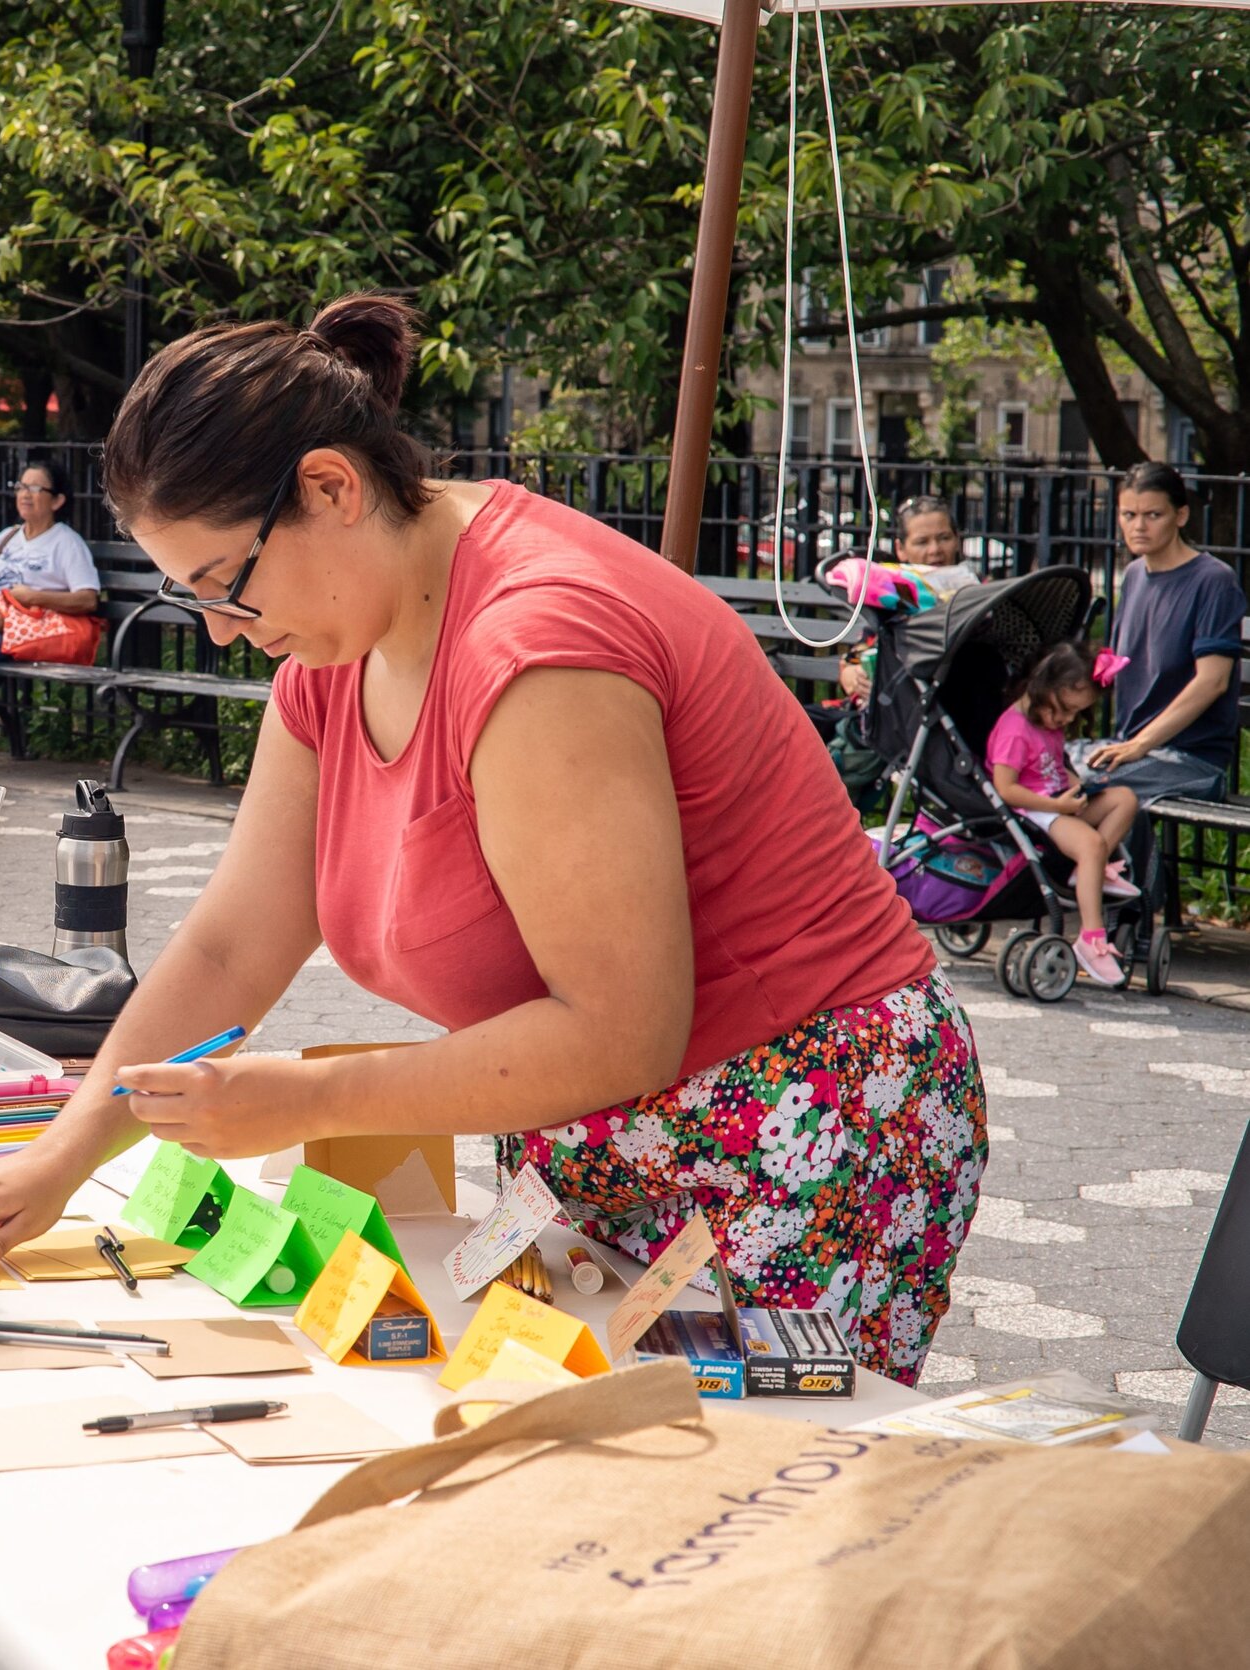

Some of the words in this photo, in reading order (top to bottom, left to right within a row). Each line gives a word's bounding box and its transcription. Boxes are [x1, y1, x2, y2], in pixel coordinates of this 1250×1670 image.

[702, 1363, 738, 1375] round
[792, 1362, 813, 1374] stic
[813, 1362, 848, 1374] round
[802, 1377, 833, 1388] BIC
[610, 1427, 890, 1590] farmhous
